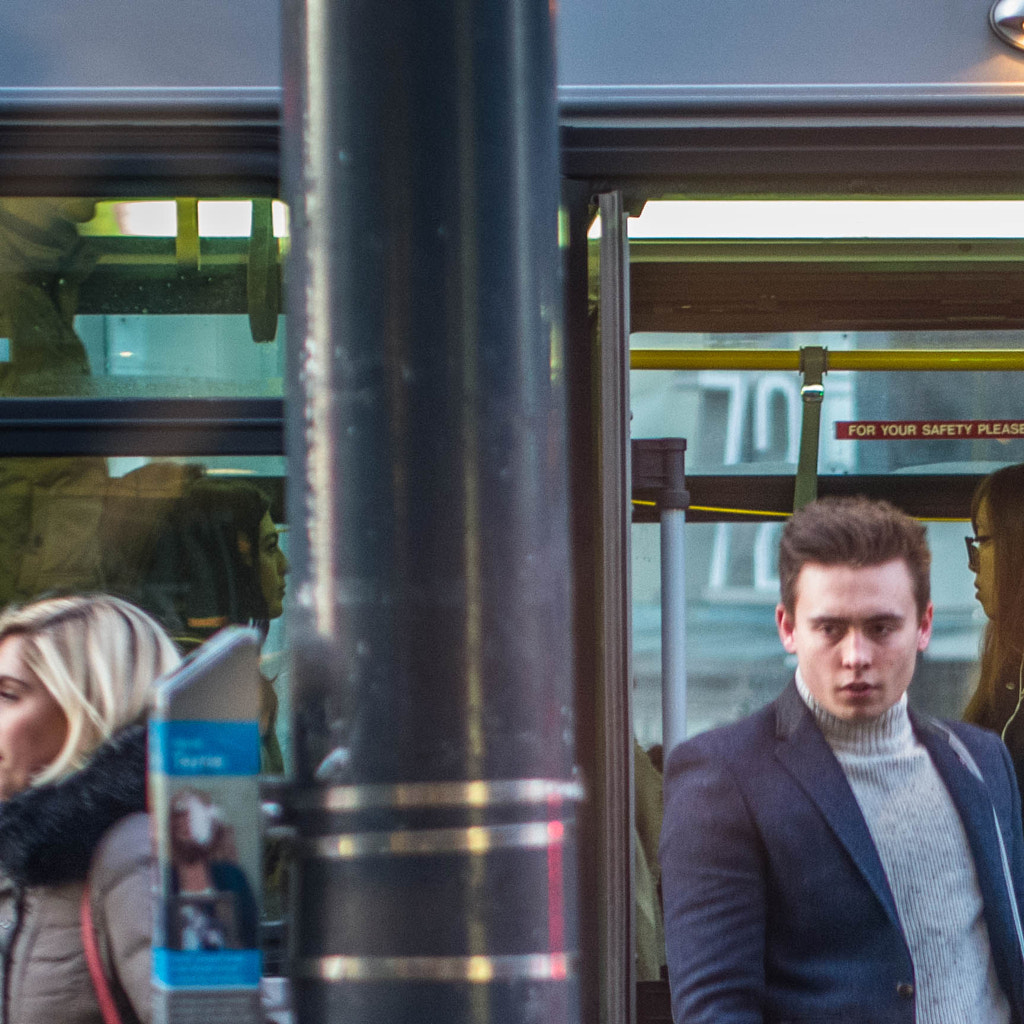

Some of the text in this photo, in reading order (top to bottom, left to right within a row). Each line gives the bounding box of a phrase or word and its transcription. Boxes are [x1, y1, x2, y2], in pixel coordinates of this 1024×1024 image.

[848, 425, 876, 436] FOR
[881, 424, 917, 436] YOUR
[922, 424, 972, 436] SAFETY
